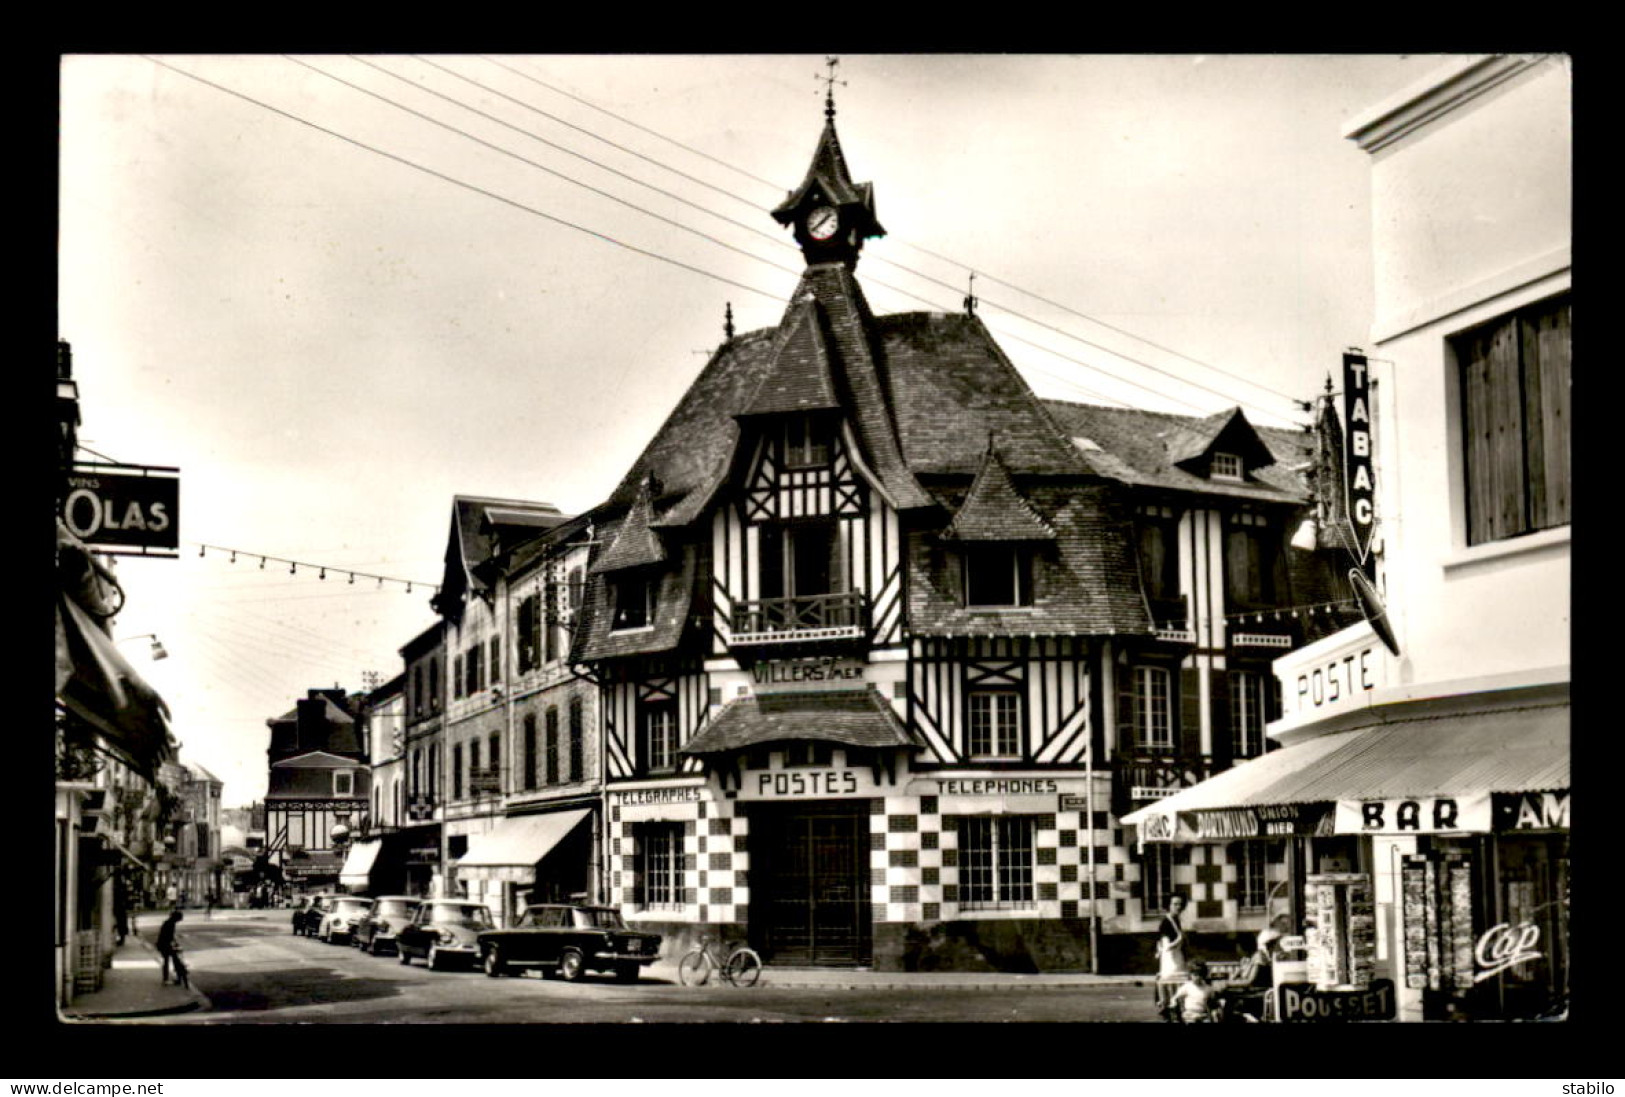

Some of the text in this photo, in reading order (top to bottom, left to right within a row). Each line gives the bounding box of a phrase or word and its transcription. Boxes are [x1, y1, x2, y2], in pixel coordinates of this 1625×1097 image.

[1350, 364, 1372, 525] TABAC
[68, 477, 100, 488] VINS
[1298, 649, 1374, 712] POSTE
[759, 771, 857, 796] POSTES
[937, 780, 1057, 793] TELEPHONES
[1361, 799, 1458, 831] BAR
[1267, 822, 1294, 834] BIER
